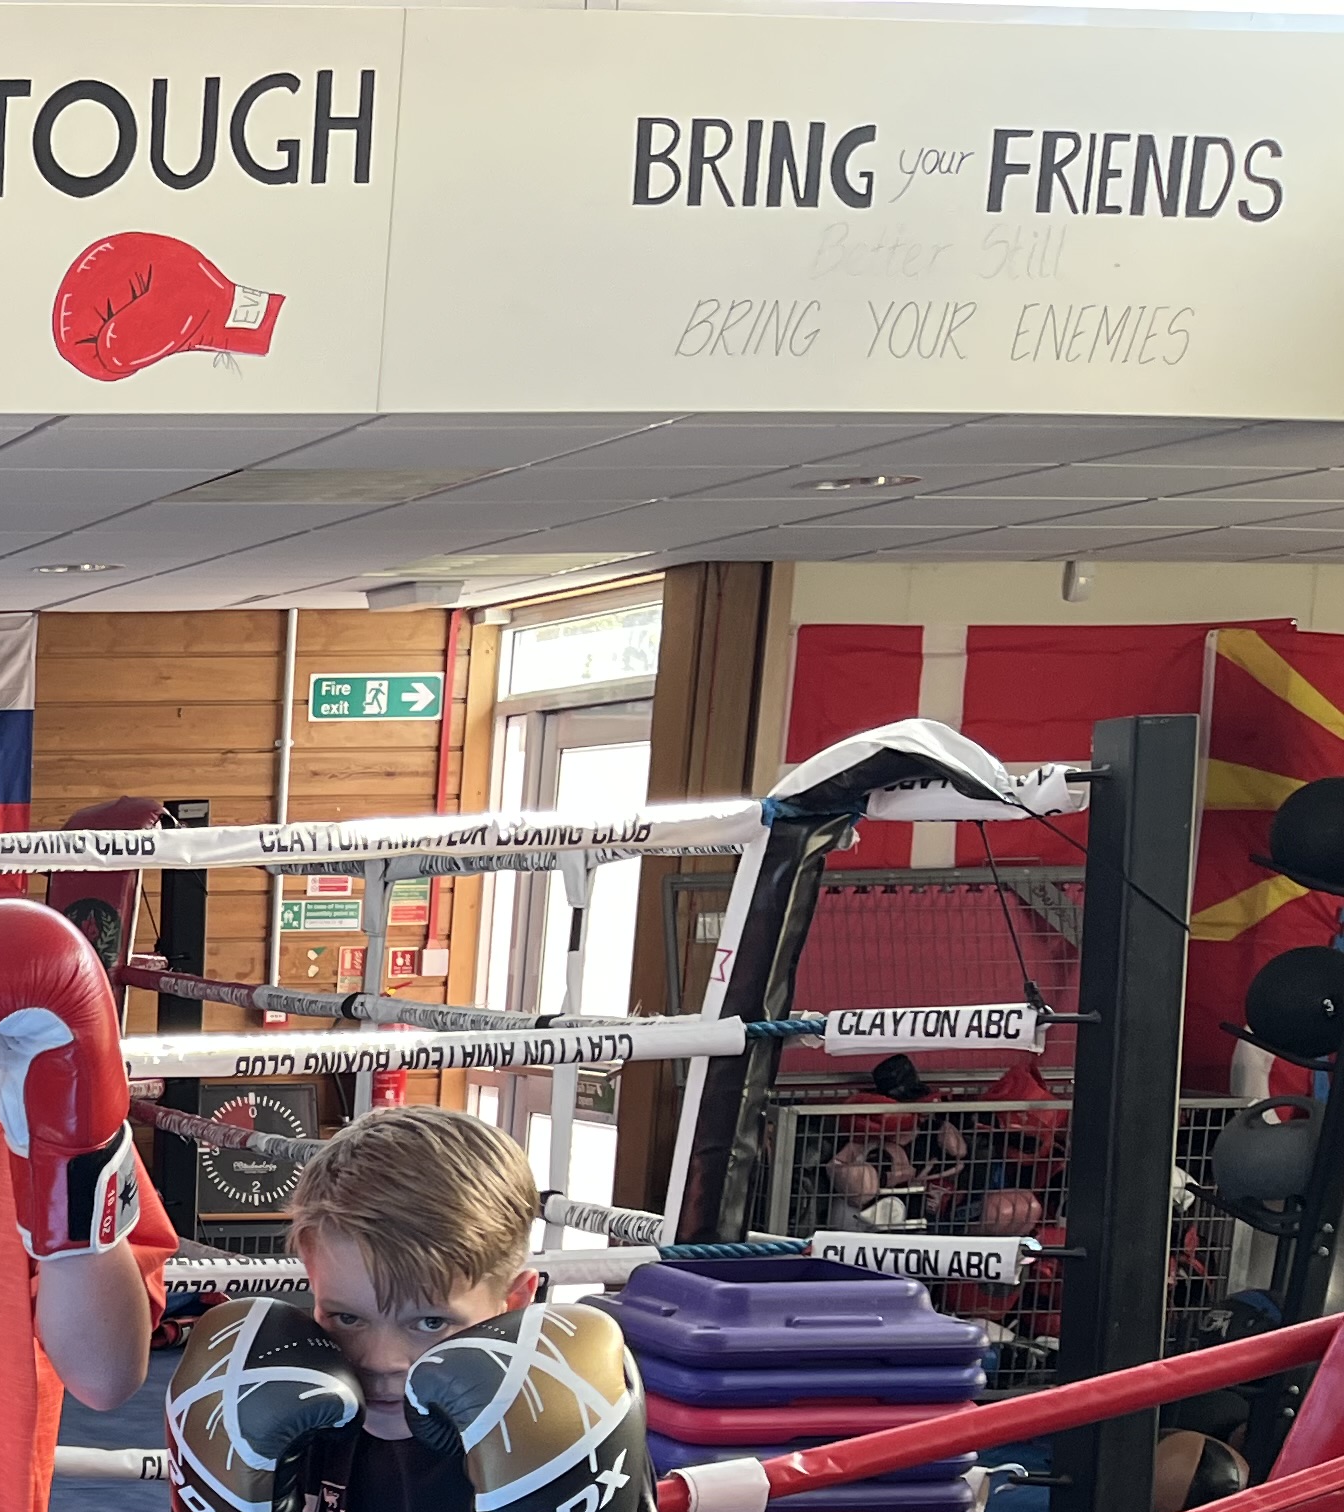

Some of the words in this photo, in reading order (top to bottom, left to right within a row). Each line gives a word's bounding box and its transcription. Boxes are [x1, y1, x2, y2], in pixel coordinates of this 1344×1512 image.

[632, 117, 877, 208] BRING
[889, 145, 975, 204] your
[986, 128, 1284, 222] FRIENDS
[674, 298, 820, 357] BRING
[868, 300, 978, 360] YOUR
[1010, 303, 1196, 367] ENEMIES
[321, 681, 351, 697] Fire
[321, 701, 350, 717] exit
[837, 1010, 958, 1038] CLAYTON
[965, 1009, 1023, 1039] ABC
[248, 1106, 257, 1119] 0
[252, 1181, 261, 1193] 2
[823, 1245, 942, 1280] CLAYTON
[948, 1251, 1002, 1281] ABC
